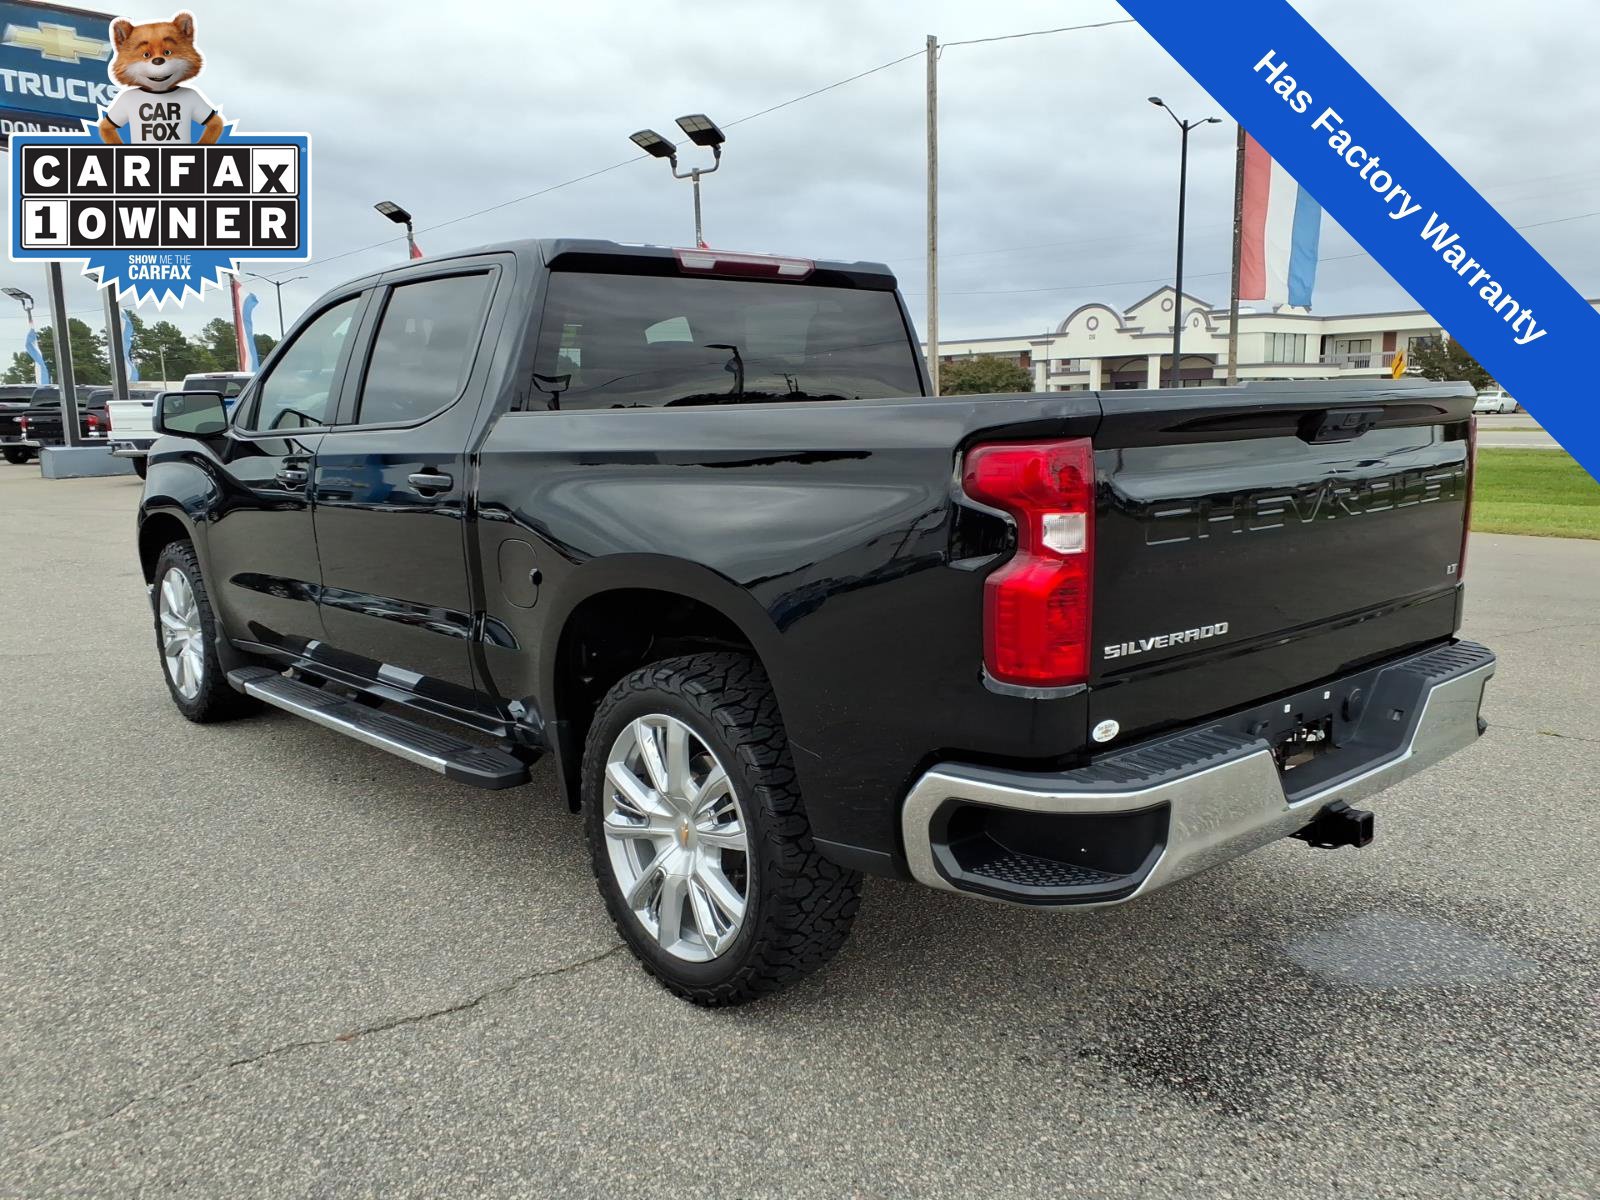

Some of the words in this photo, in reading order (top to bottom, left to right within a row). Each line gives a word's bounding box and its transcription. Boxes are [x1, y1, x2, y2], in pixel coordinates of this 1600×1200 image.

[1, 119, 41, 135] DON
[1446, 563, 1458, 575] LT
[1104, 622, 1229, 660] SILVERADO
